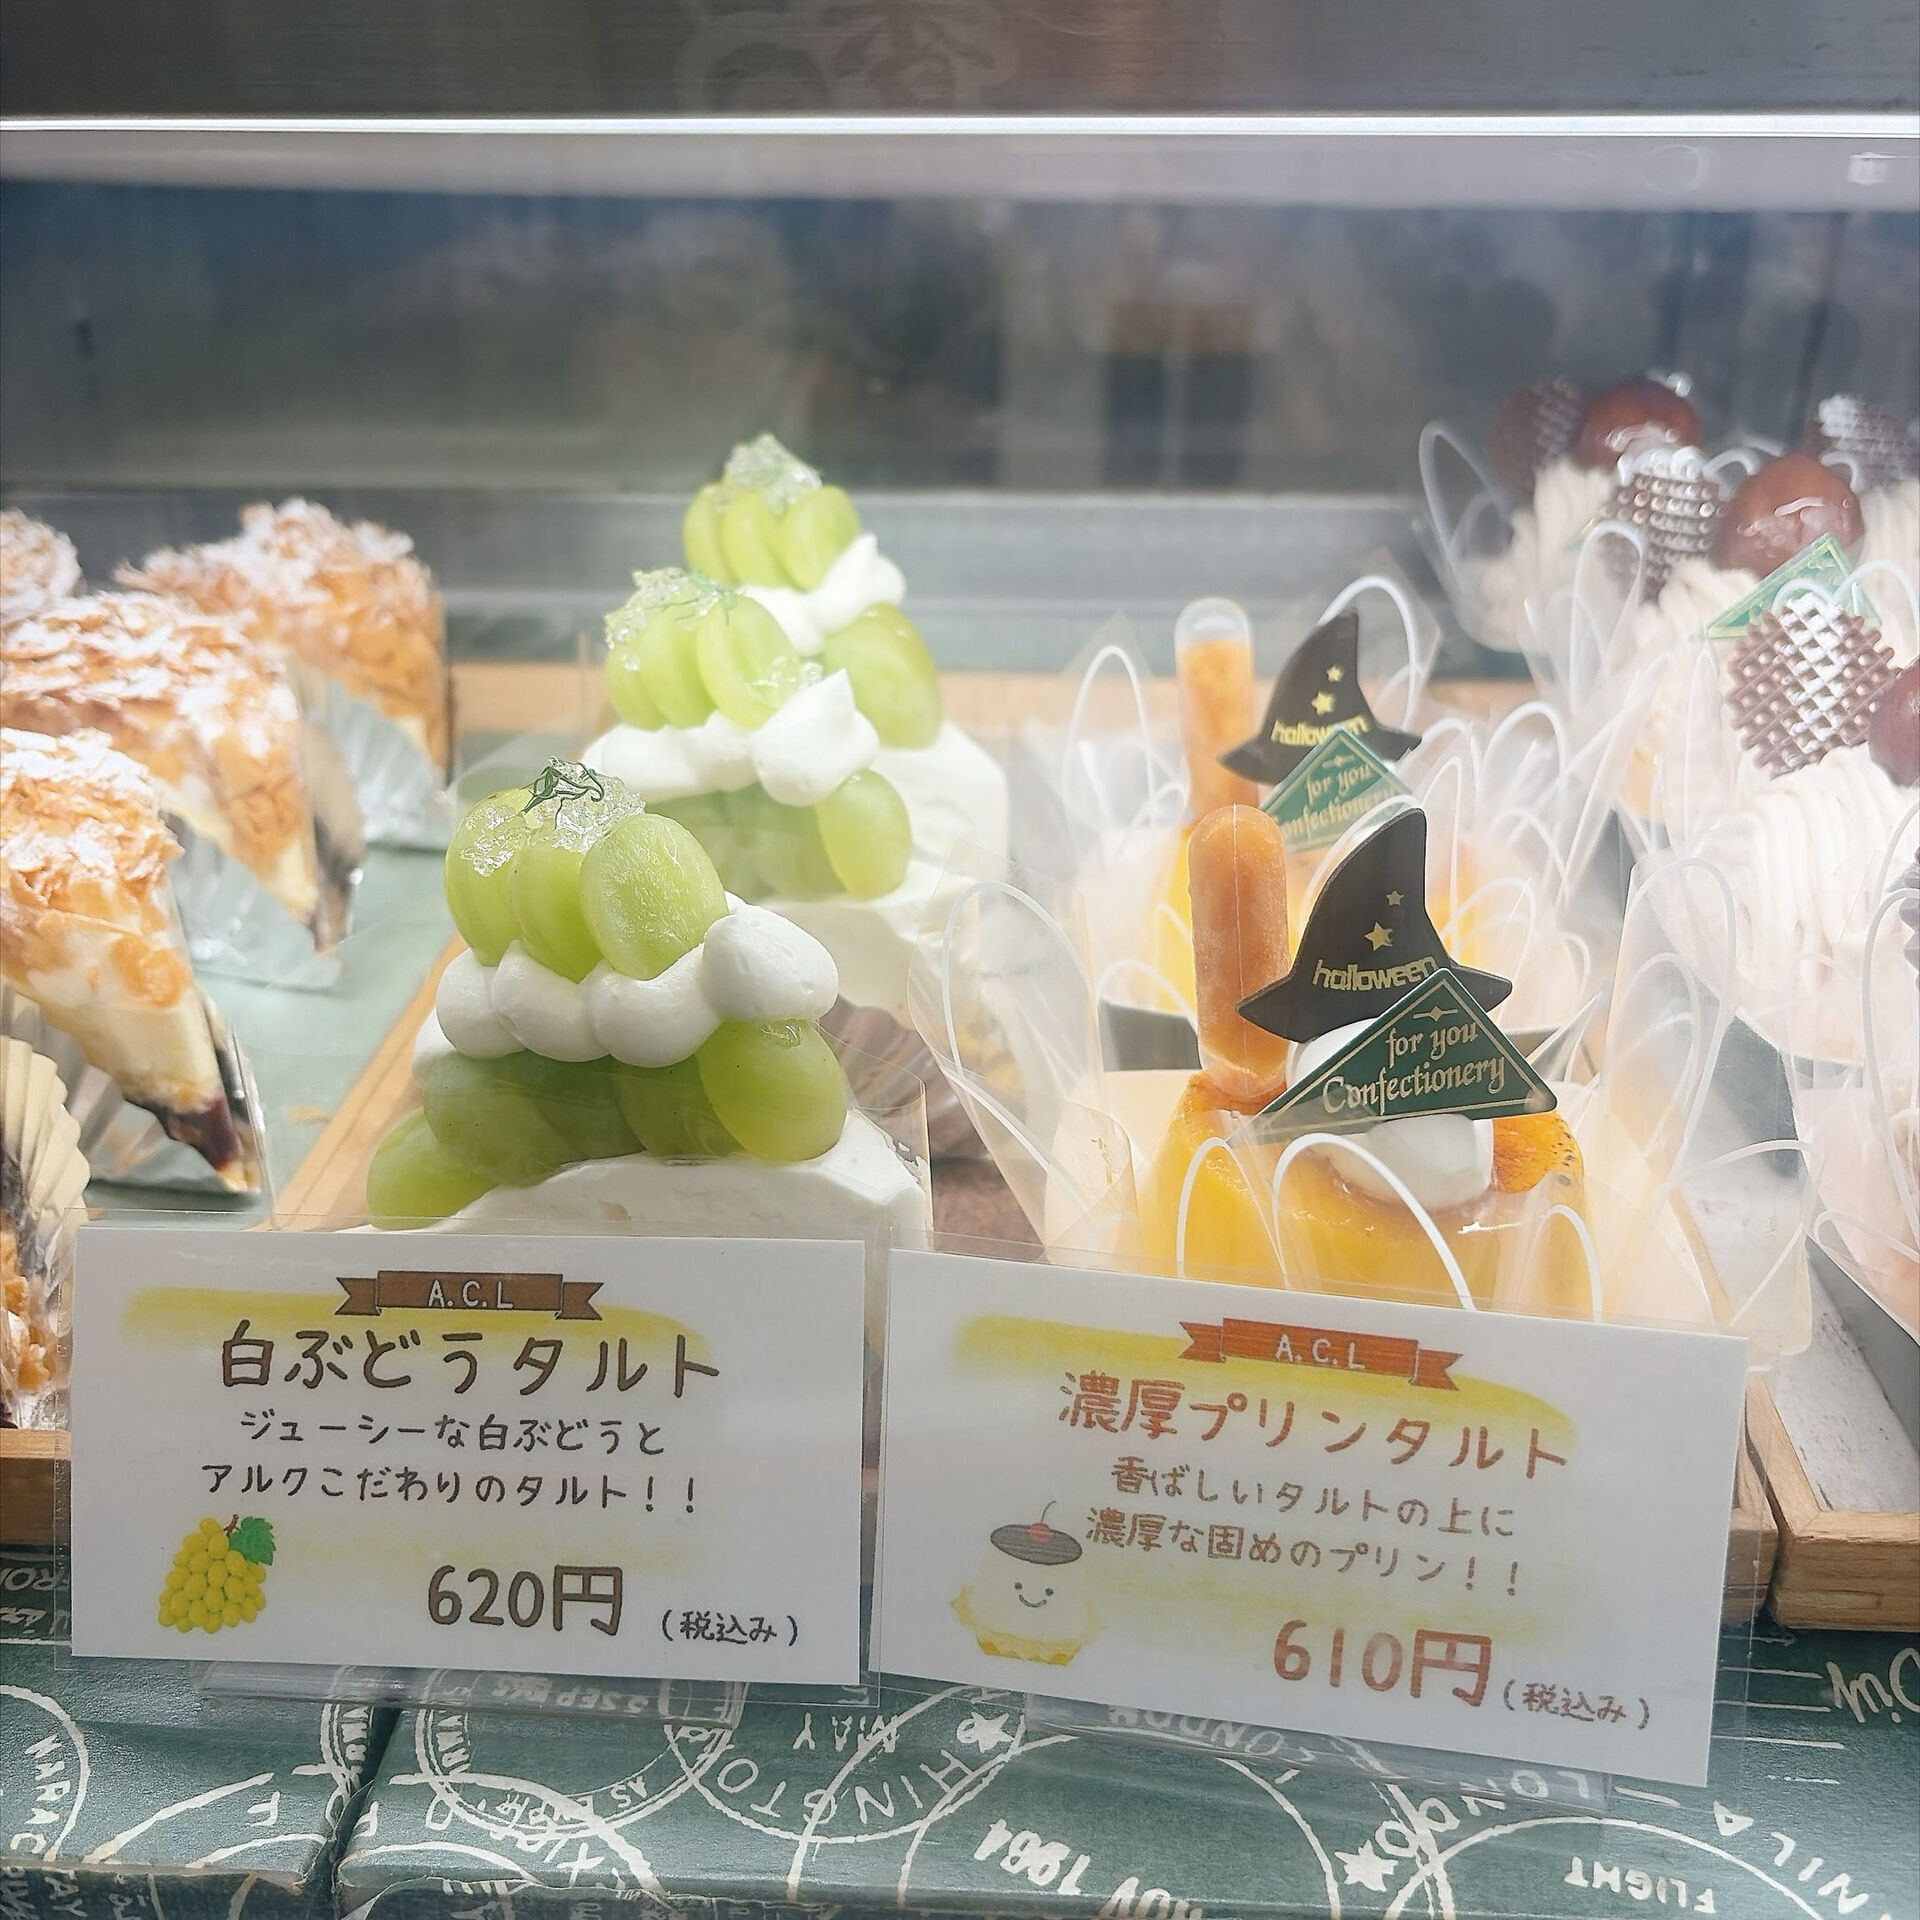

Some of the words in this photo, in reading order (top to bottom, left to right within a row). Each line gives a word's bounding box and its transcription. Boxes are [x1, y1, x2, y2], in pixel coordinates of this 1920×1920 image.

[1312, 955, 1437, 992] halloween
[1386, 1027, 1424, 1067] for
[1430, 1018, 1479, 1062] you
[1321, 1055, 1506, 1117] Confectionery
[427, 1279, 515, 1310] A.C.L
[221, 1319, 720, 1398] 白ぶどうタルト
[1274, 1332, 1366, 1372] A.C.L
[240, 1407, 666, 1456] ジューシーな白ぶどうと
[1057, 1369, 1569, 1481] 濃厚プリンタルト
[1110, 1454, 1517, 1538] 香ばしいタルトの上に
[427, 1564, 624, 1636] 620円
[1273, 1618, 1494, 1708] 610円
[1563, 1856, 1717, 1916] FLIGHT
